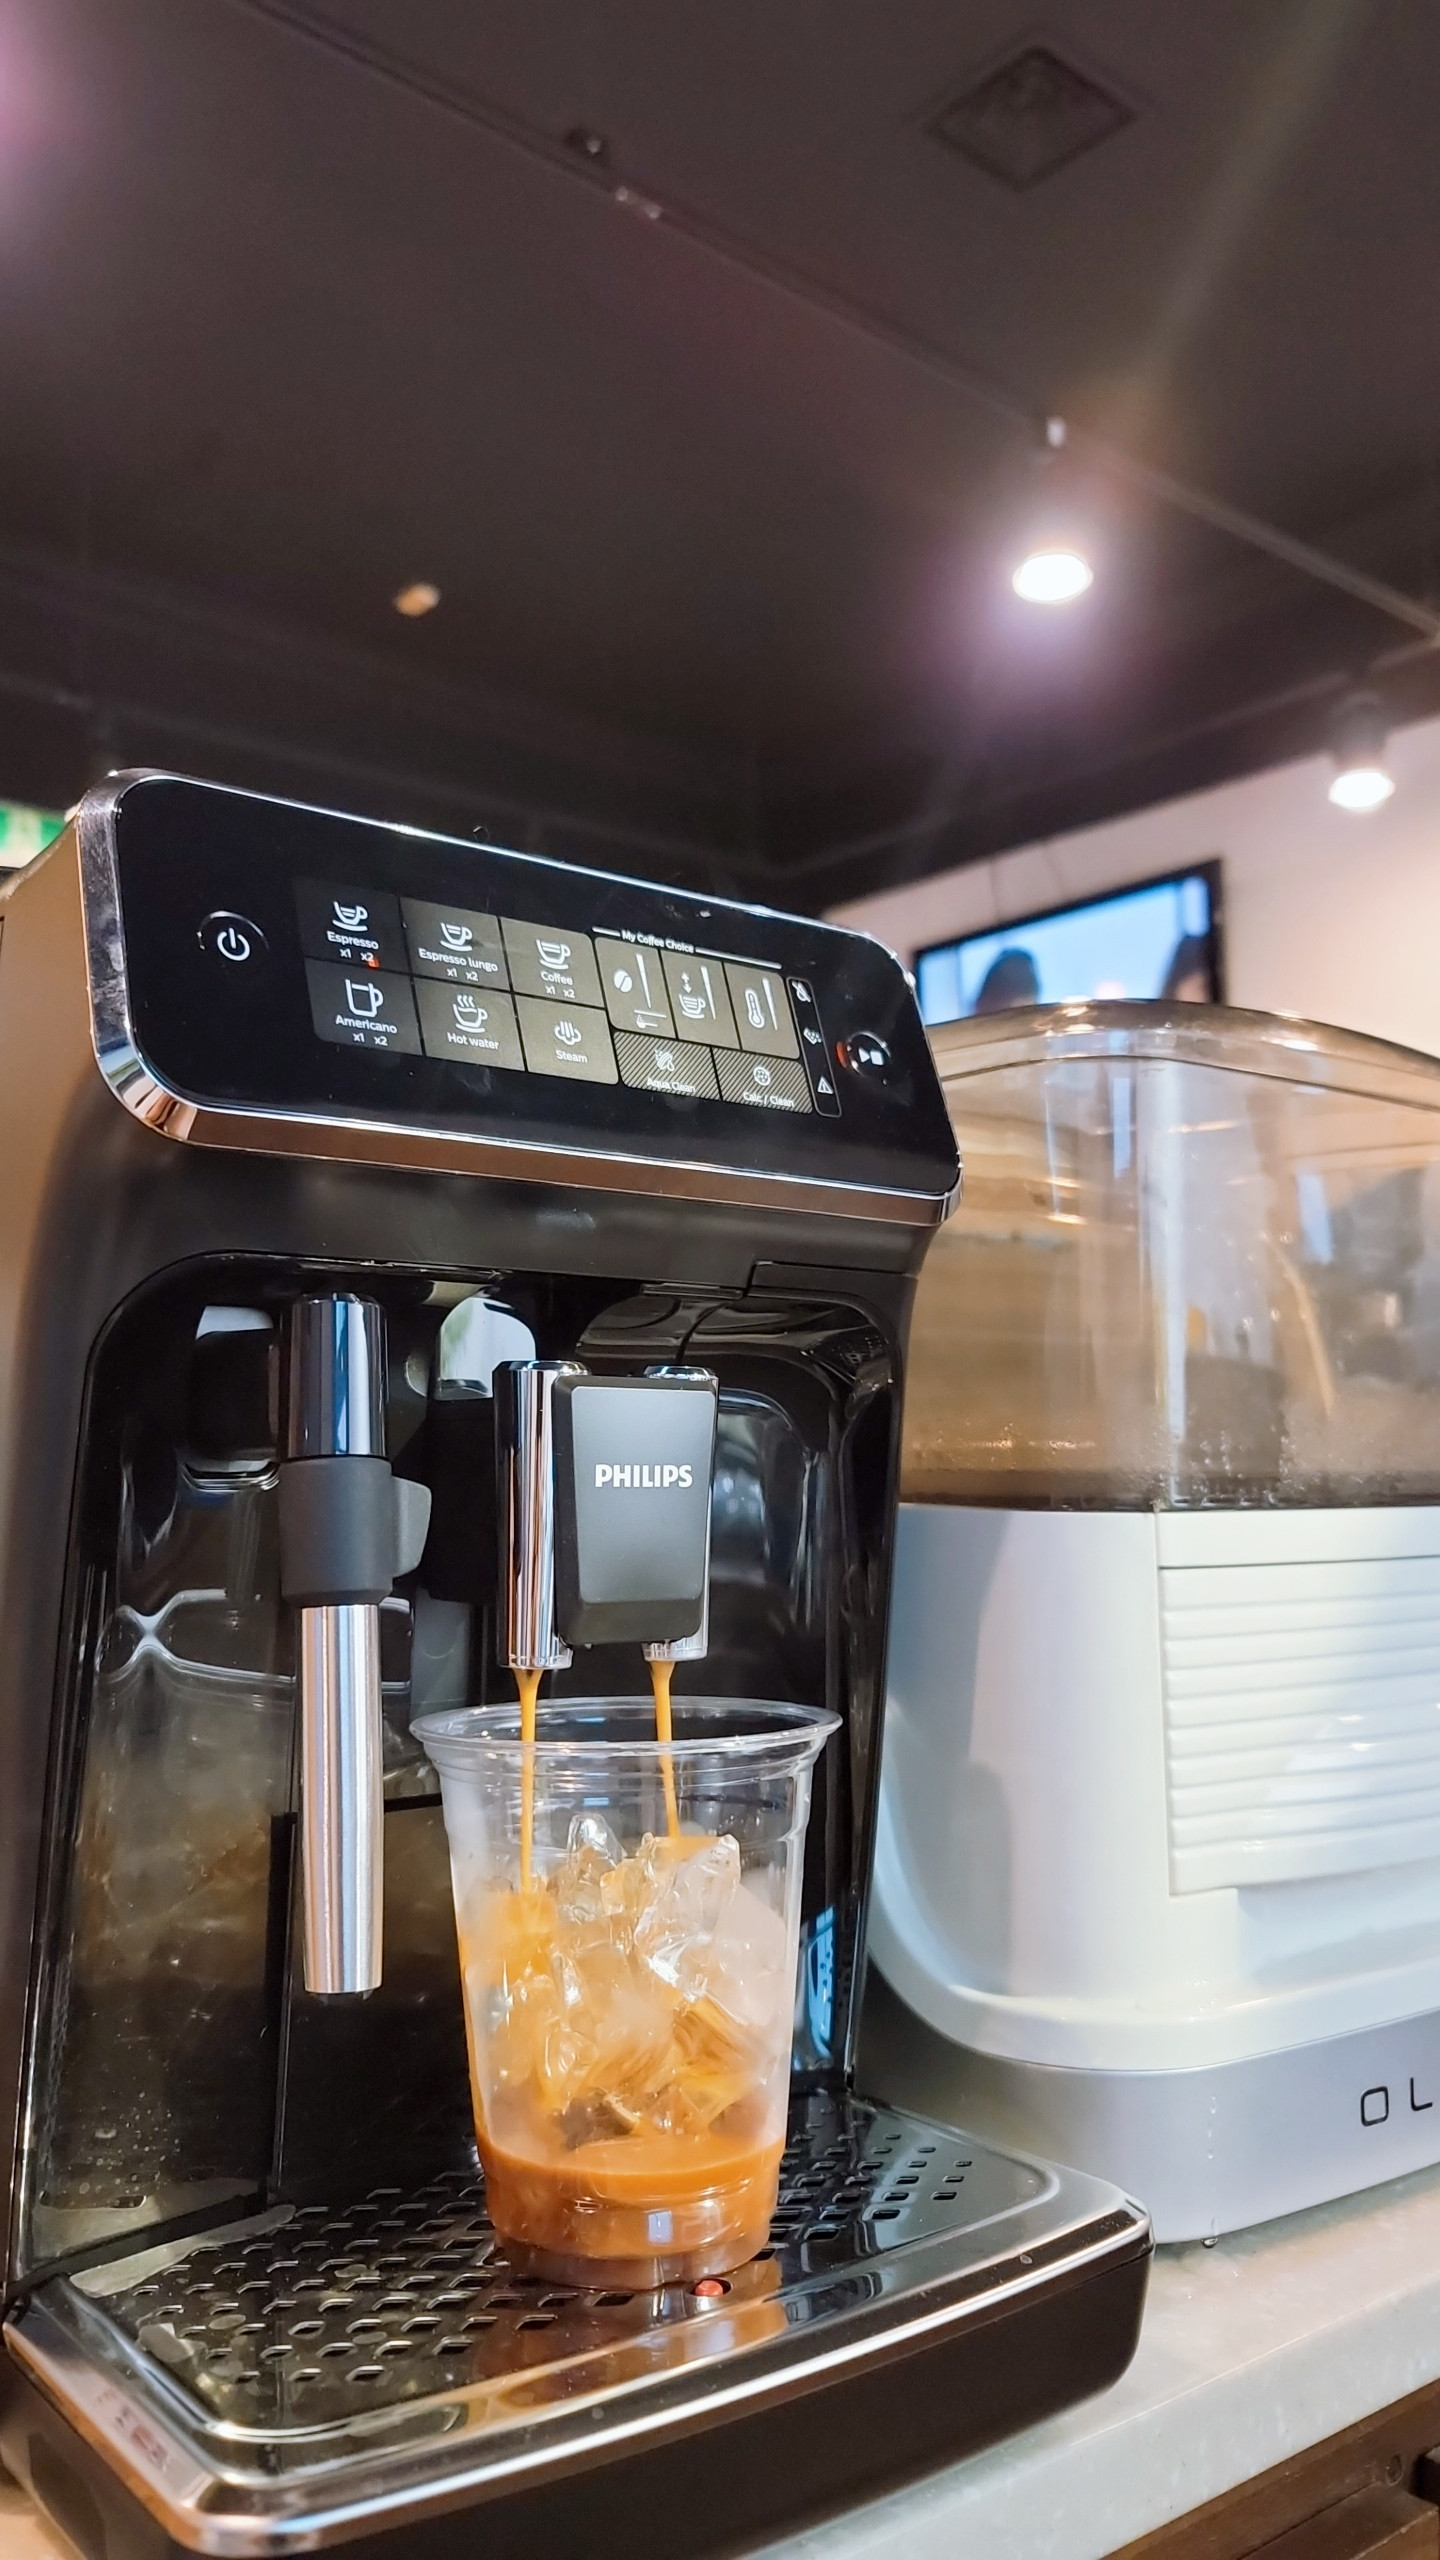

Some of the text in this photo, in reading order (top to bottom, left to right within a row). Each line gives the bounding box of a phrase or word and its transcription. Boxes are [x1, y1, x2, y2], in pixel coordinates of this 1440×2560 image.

[326, 930, 379, 949] Espresso
[621, 930, 694, 953] My Coffee Choice
[340, 949, 374, 962] x1 x2
[418, 948, 498, 972] Espresso lungo
[447, 968, 478, 981] x1 x2
[540, 970, 573, 986] Coffee
[545, 986, 575, 999] x1 x2
[335, 1015, 397, 1034] Americano
[353, 1033, 388, 1046] x1 x2
[447, 1032, 499, 1050] Hot water
[555, 1050, 588, 1063] Steam
[647, 1077, 696, 1093] Aqua Clean
[743, 1092, 762, 1103] Calc
[770, 1096, 795, 1108] Clean
[594, 1464, 693, 1488] PHILIPS
